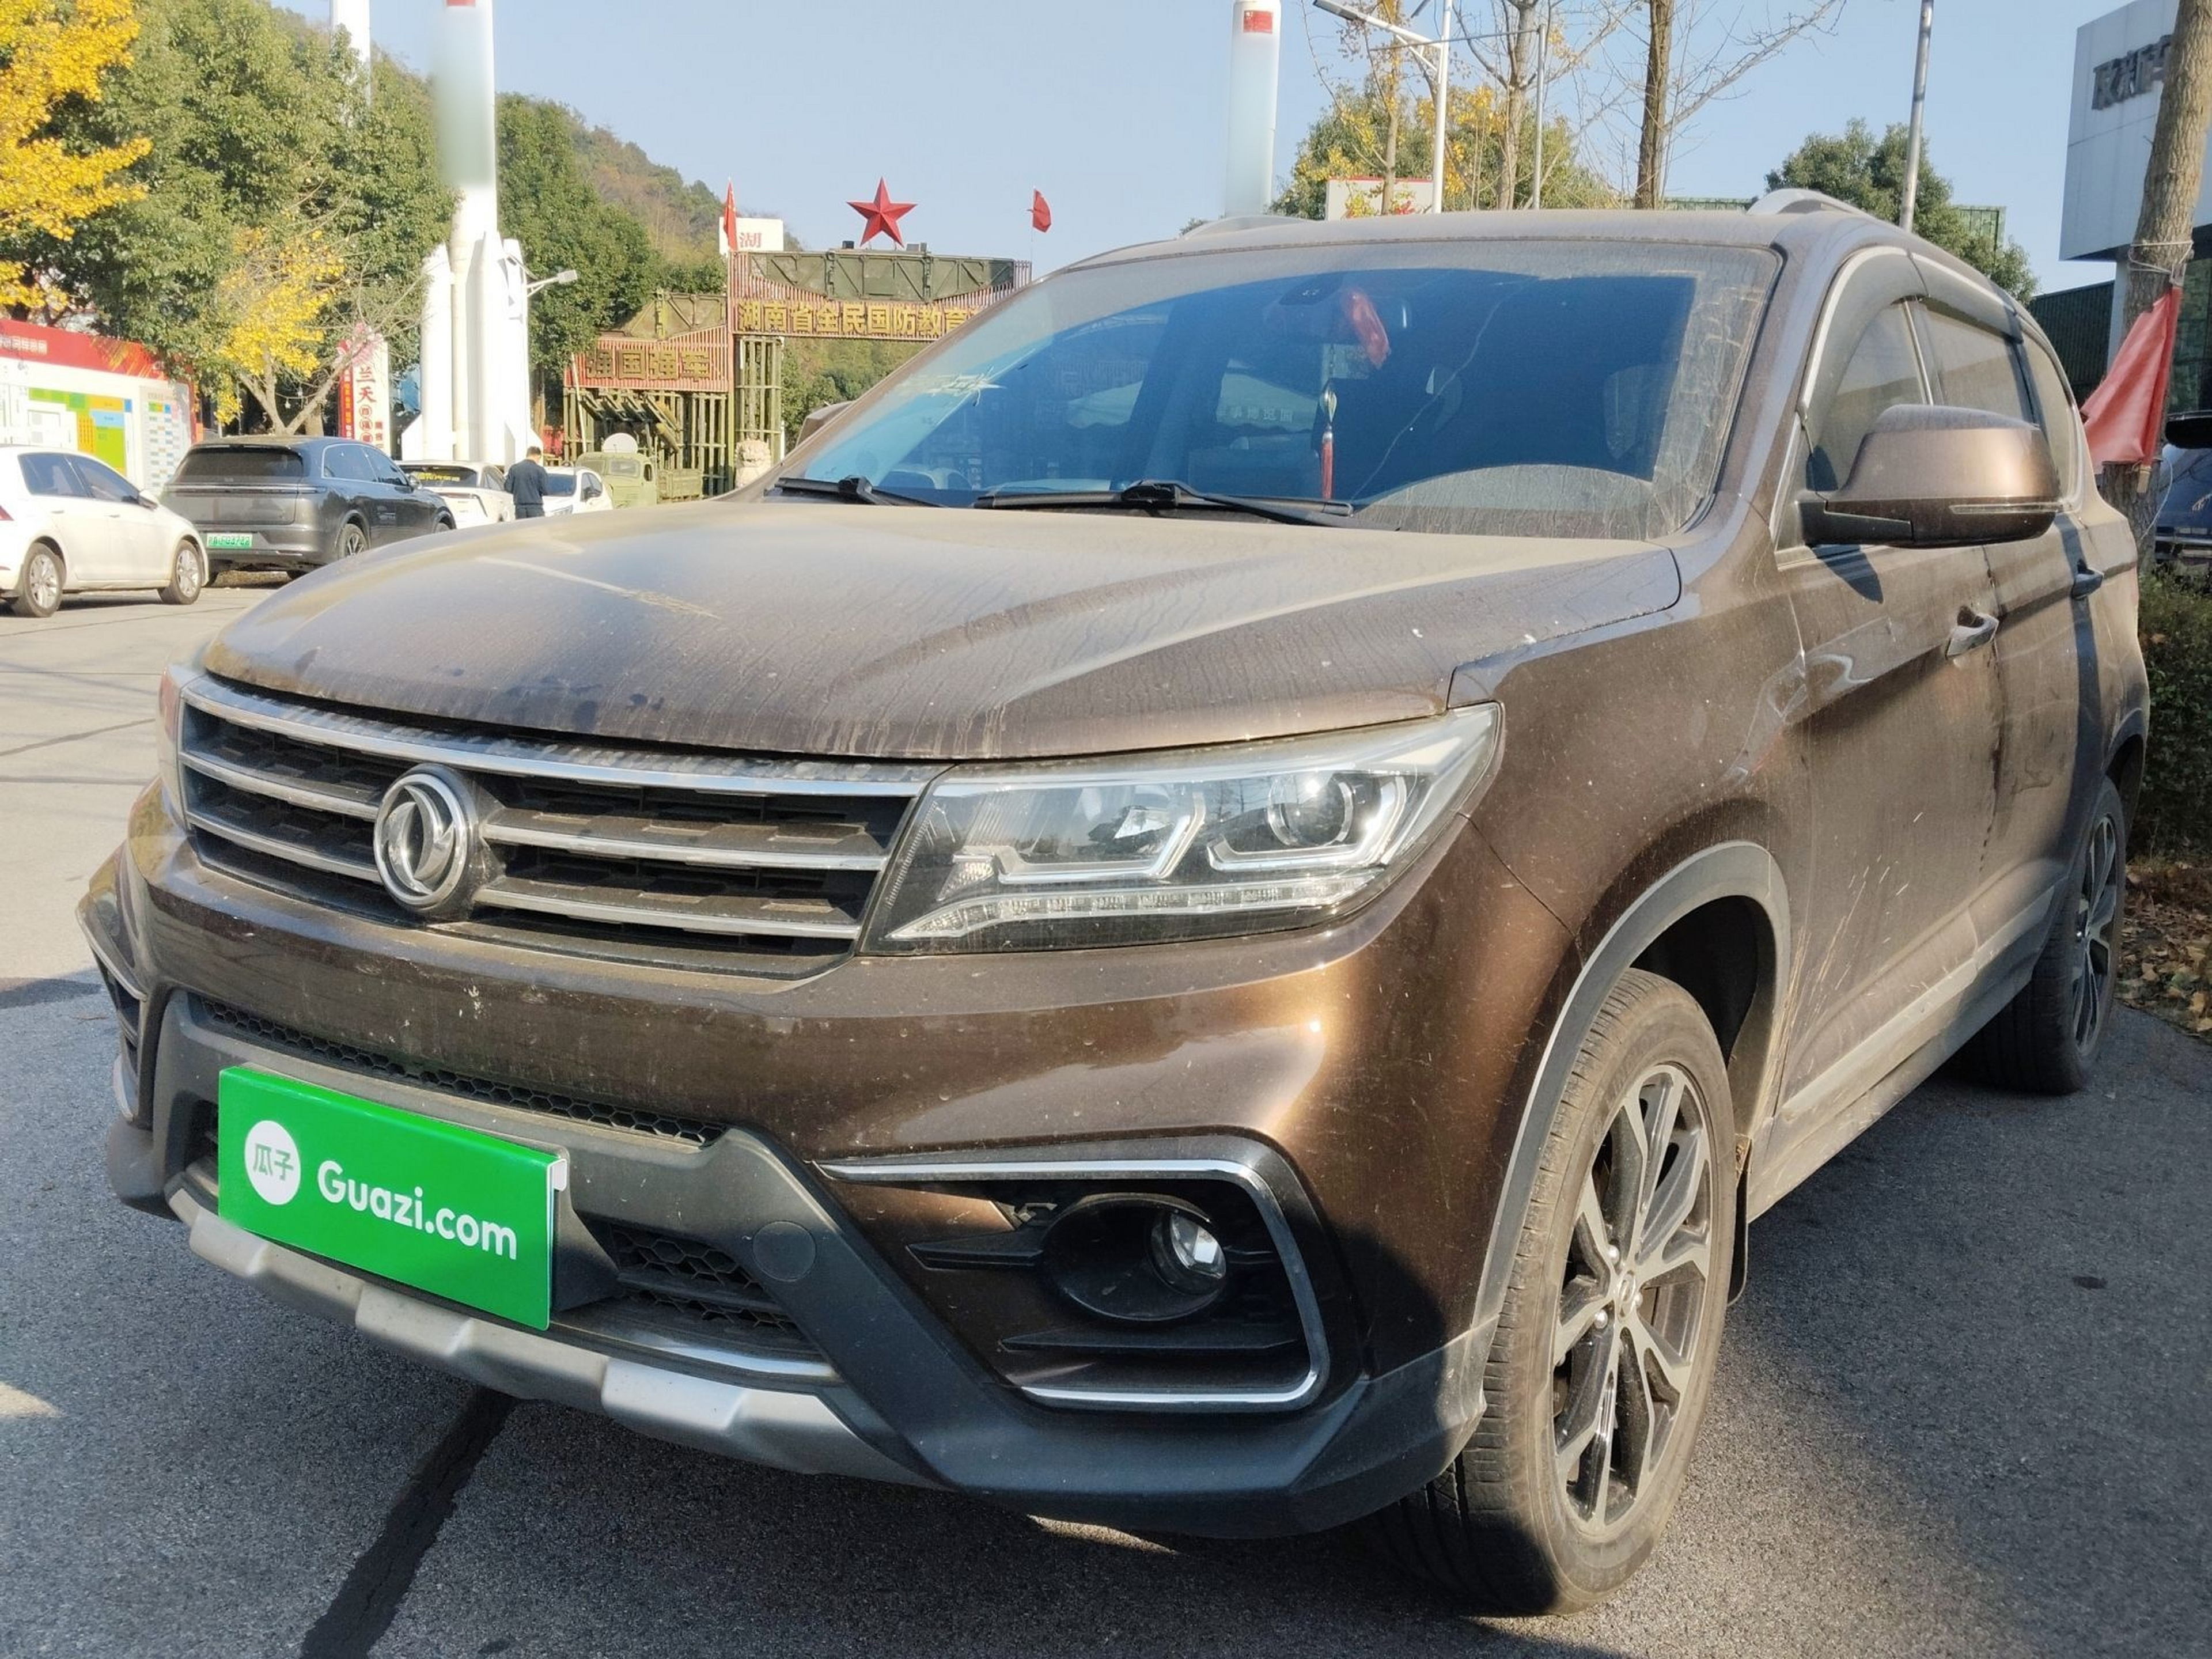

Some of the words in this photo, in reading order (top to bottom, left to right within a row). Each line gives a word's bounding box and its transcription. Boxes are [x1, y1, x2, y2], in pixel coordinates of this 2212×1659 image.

[738, 301, 980, 337] 湖南省全民国防教育
[252, 1143, 294, 1181] 瓜子
[317, 1160, 517, 1260] Guazi.com
